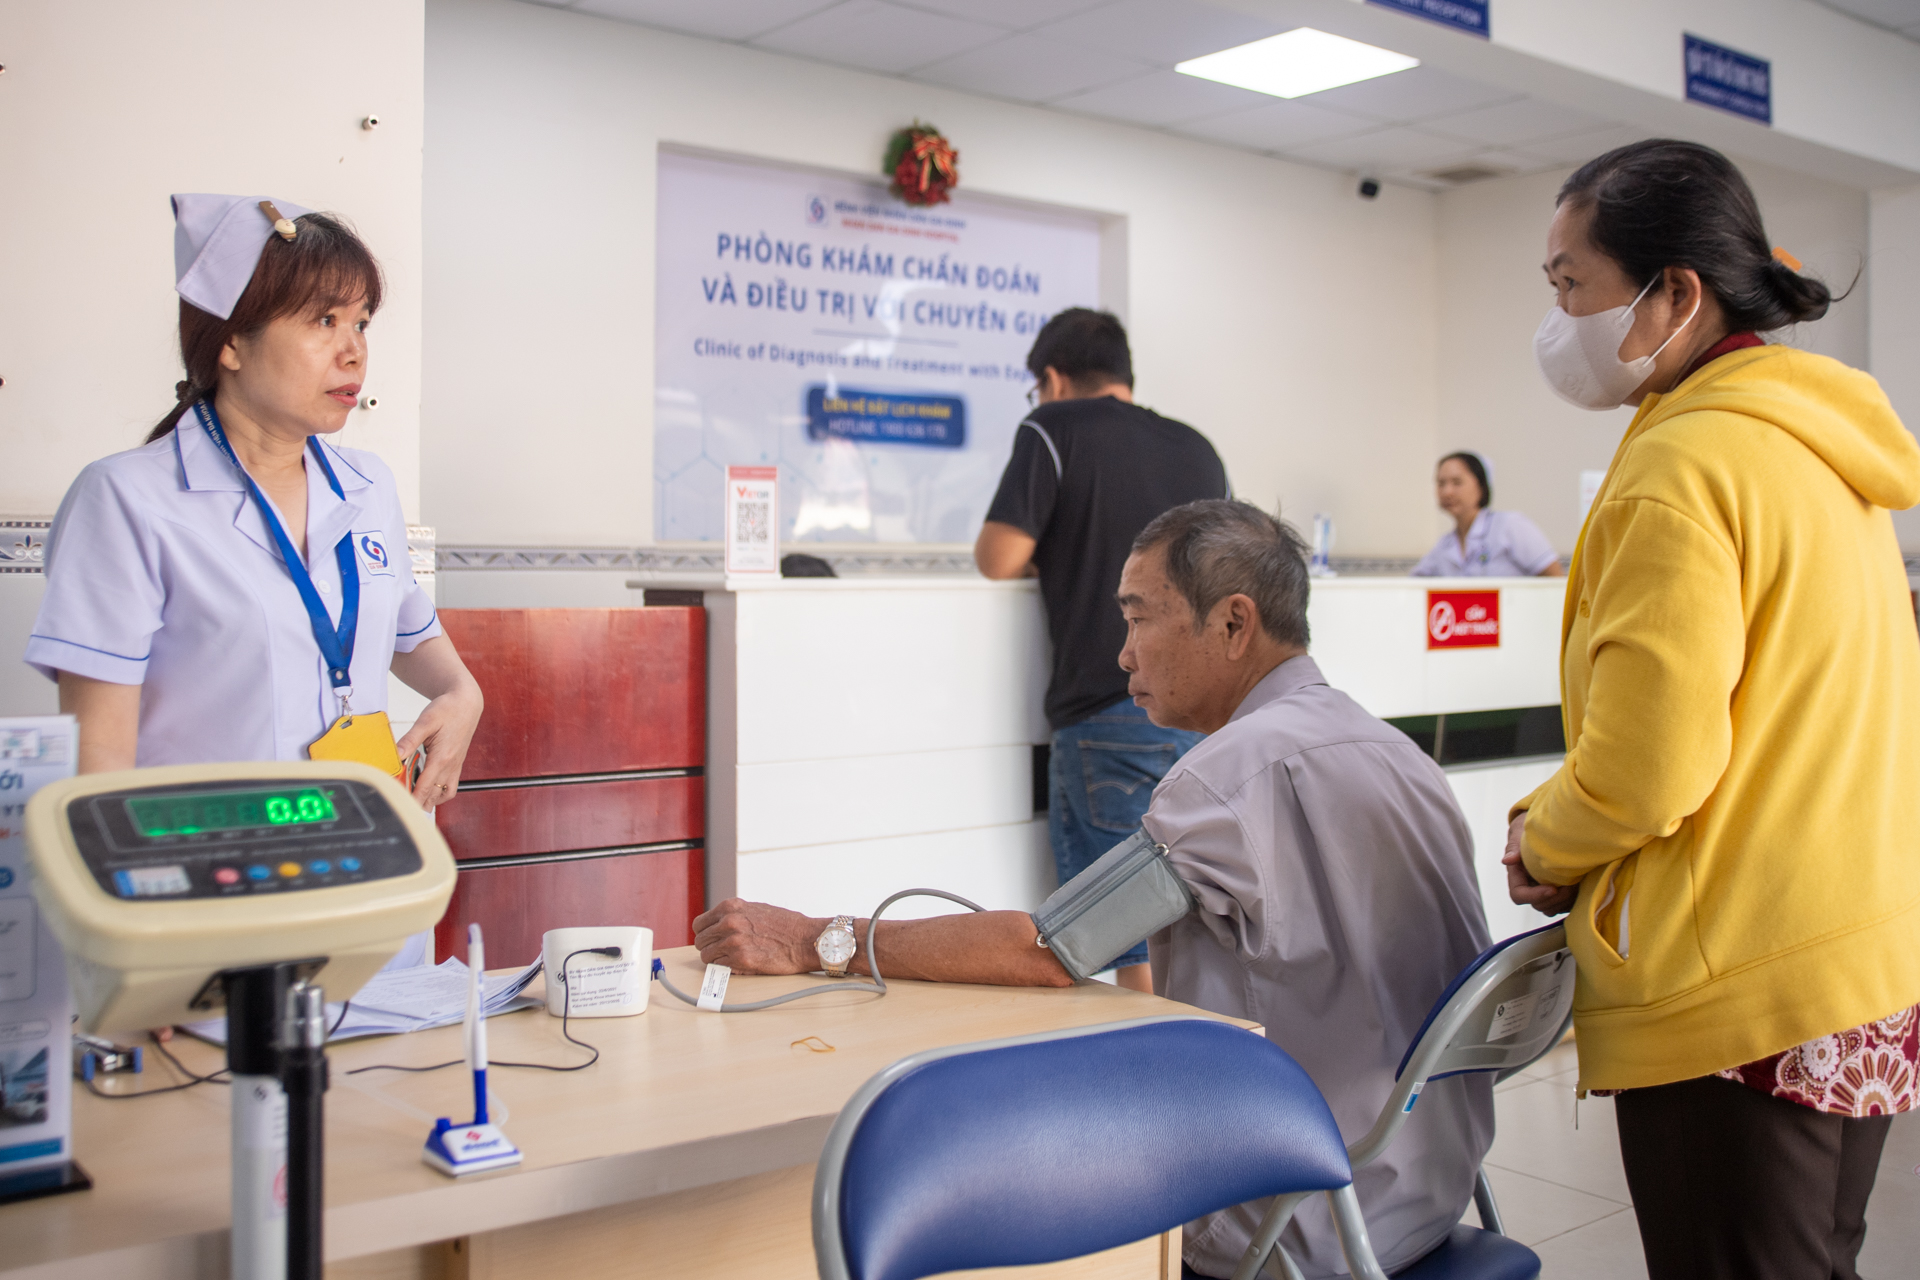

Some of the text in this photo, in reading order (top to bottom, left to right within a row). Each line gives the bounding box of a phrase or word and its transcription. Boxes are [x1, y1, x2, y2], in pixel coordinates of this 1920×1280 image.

[717, 230, 1040, 294] PHÒNG KHÁM CHẤN ĐOÁN
[702, 272, 737, 305] VÀ
[747, 276, 807, 312] ĐIỀU
[818, 289, 855, 323] TRỊ
[914, 300, 1006, 331] CHUYÊN
[693, 338, 742, 359] Clinic
[747, 343, 765, 361] of
[769, 345, 848, 367] Diagnosis
[969, 363, 1000, 379] with
